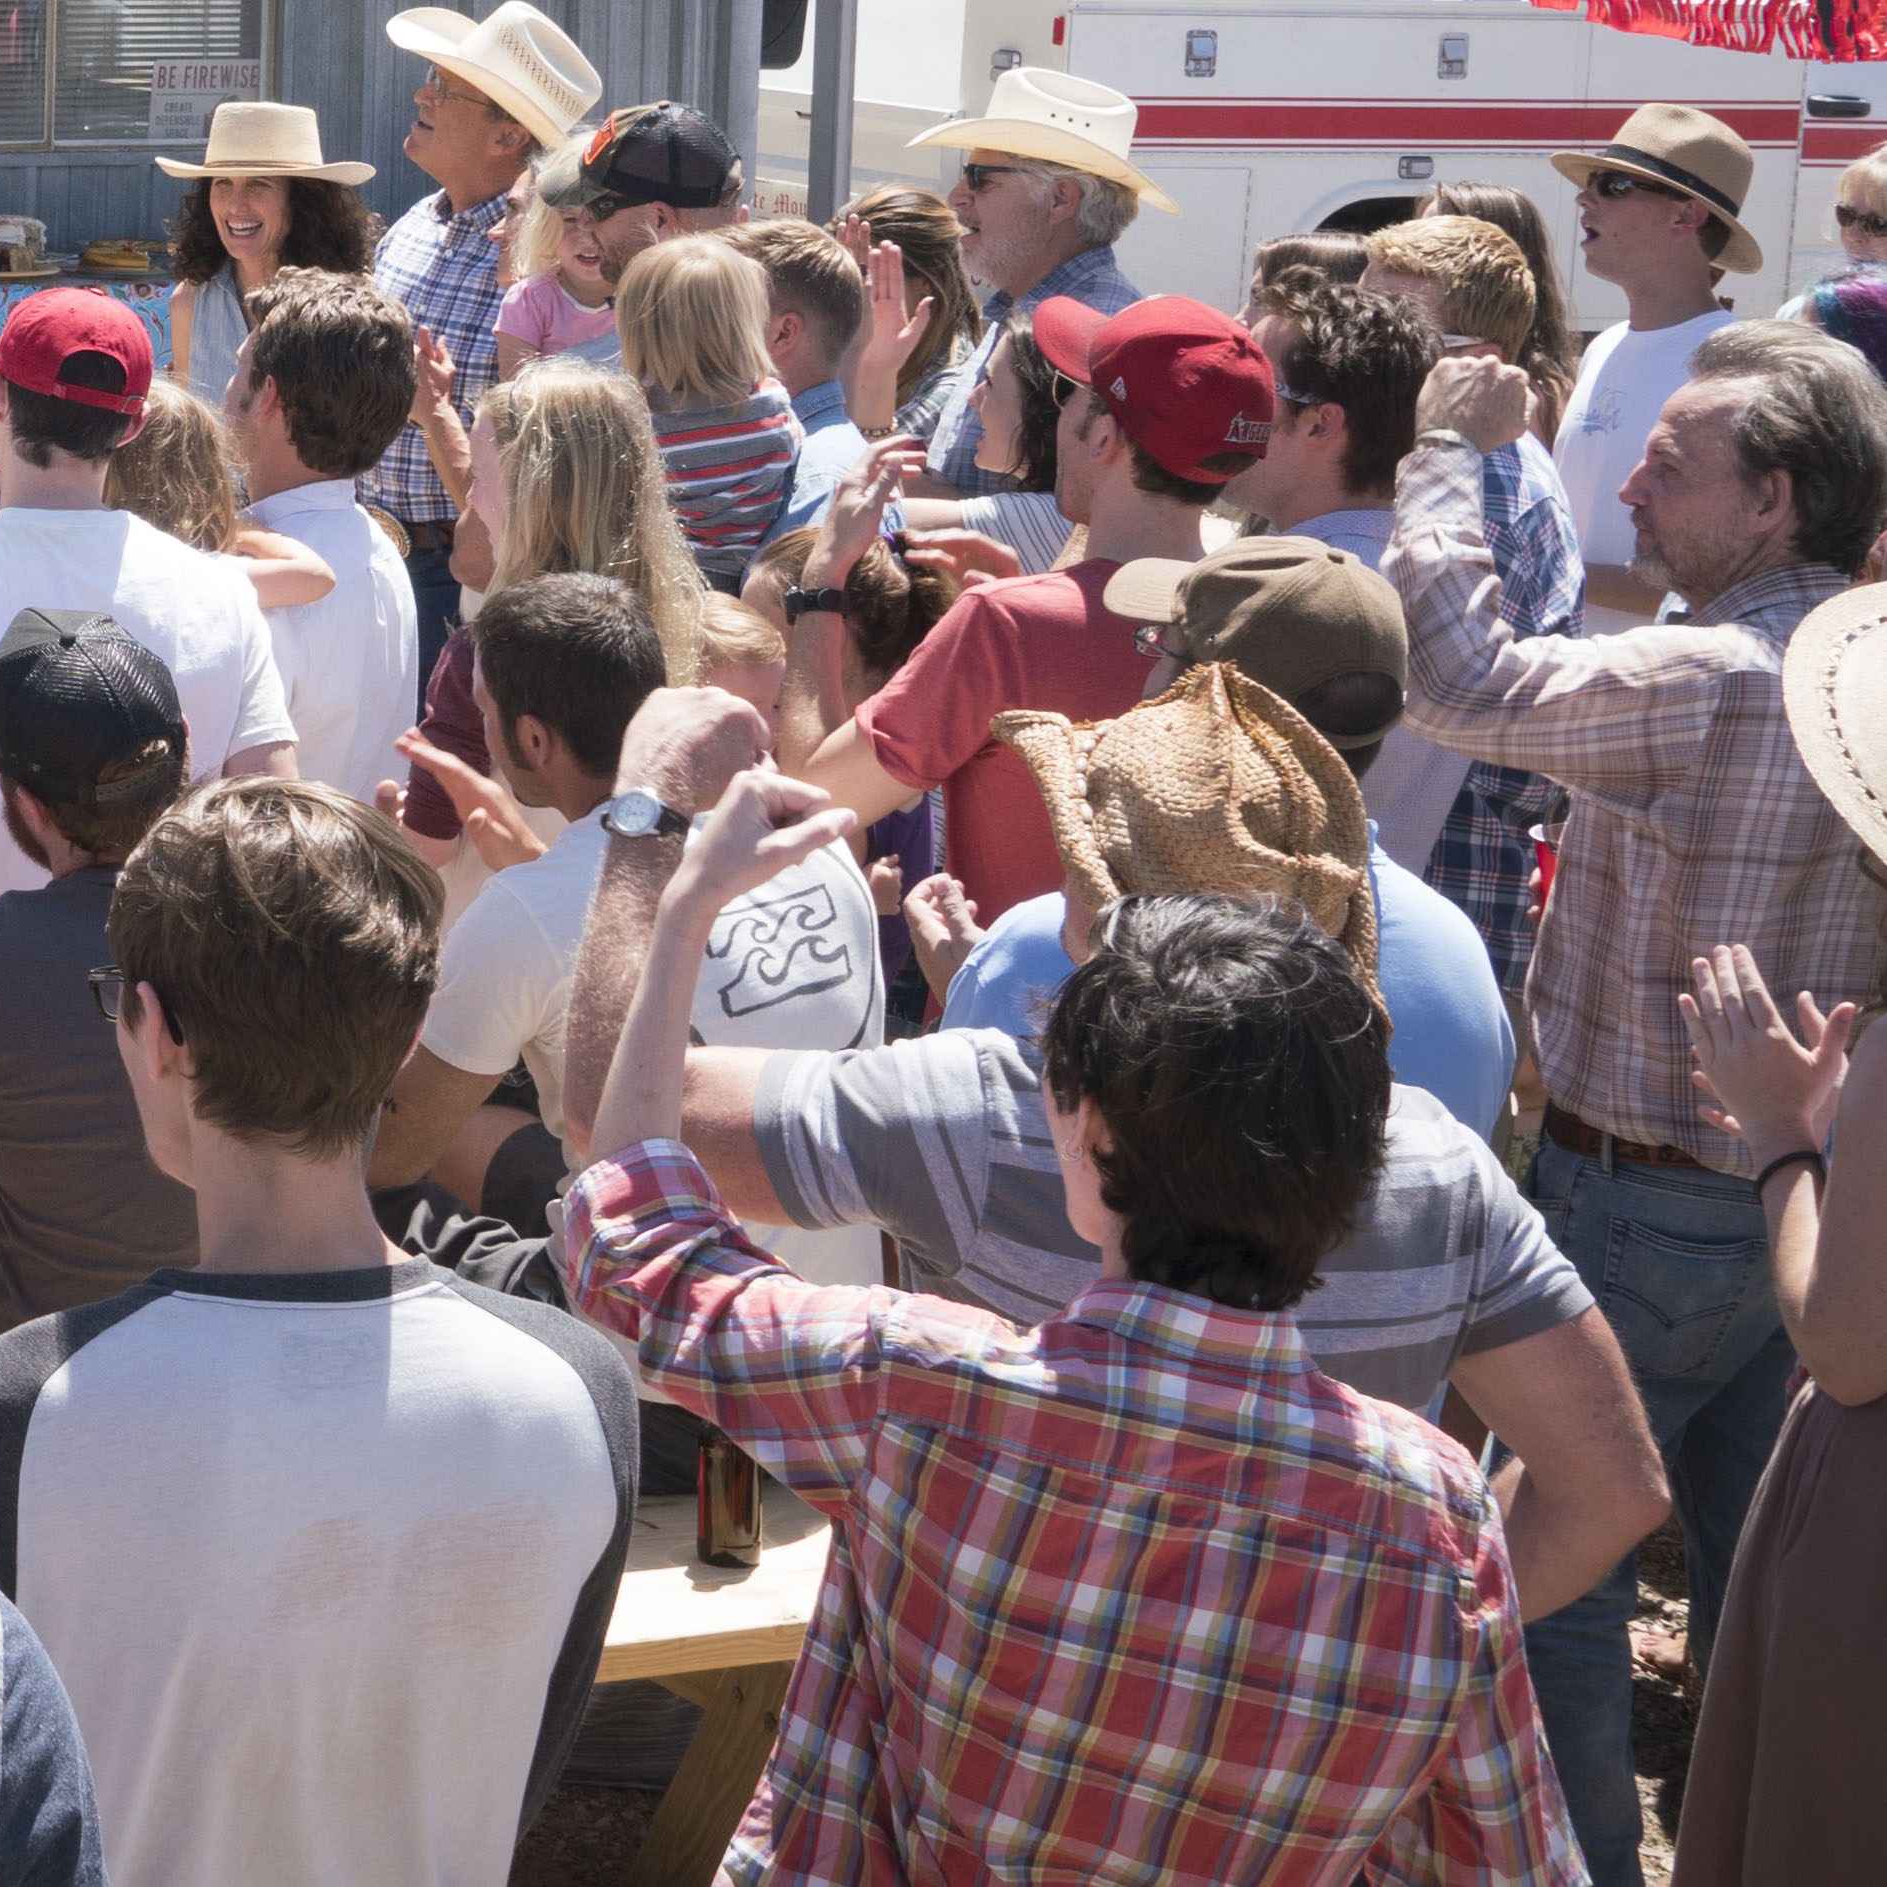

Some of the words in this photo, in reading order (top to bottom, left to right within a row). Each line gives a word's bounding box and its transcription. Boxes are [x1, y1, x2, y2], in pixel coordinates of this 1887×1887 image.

[157, 65, 178, 89] BE
[183, 64, 260, 89] FIREWISE
[163, 101, 194, 113] CREATE
